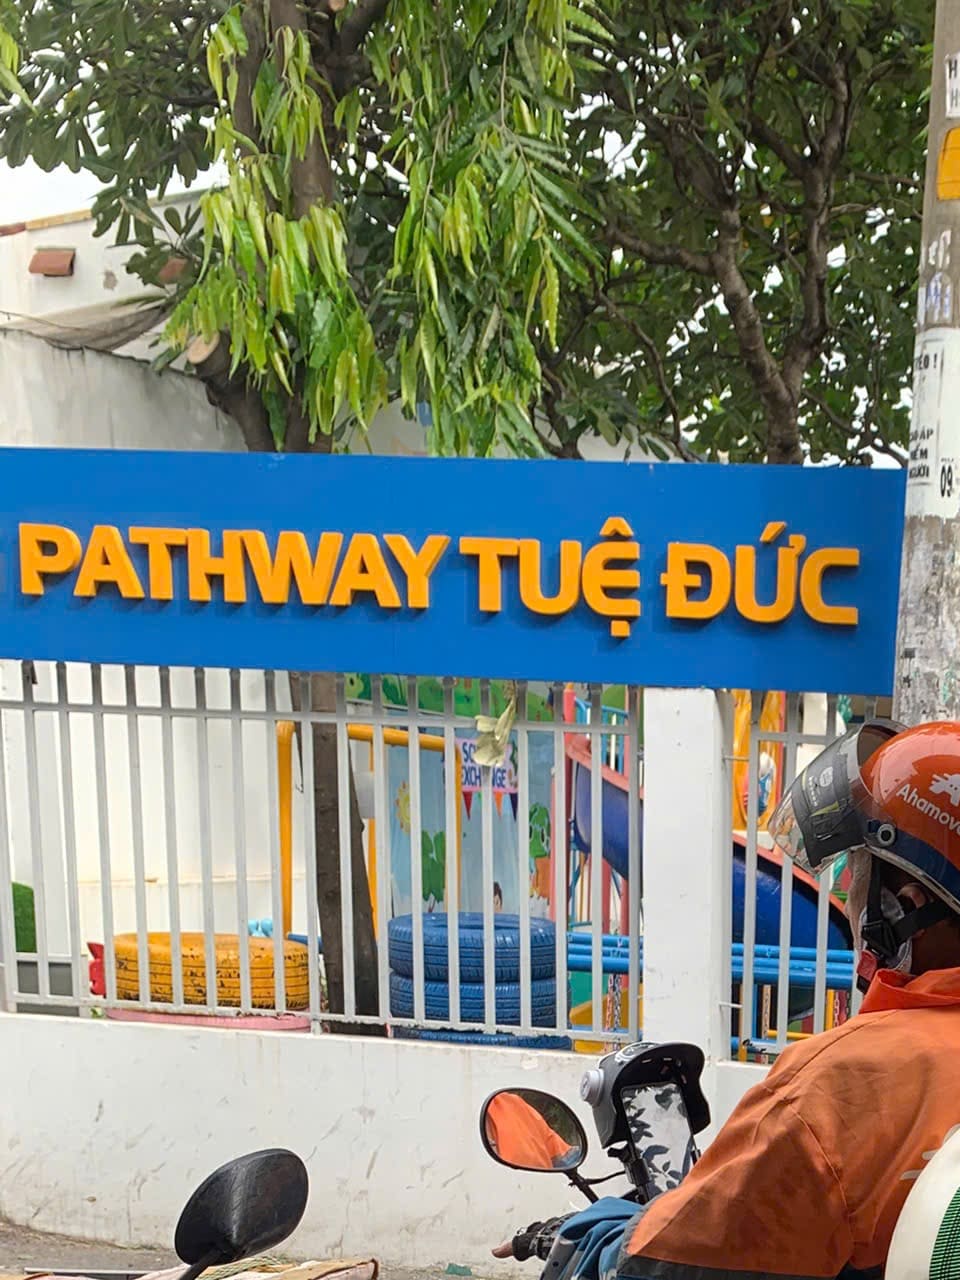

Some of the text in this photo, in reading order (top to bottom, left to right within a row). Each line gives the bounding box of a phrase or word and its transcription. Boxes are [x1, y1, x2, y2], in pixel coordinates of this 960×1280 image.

[18, 516, 860, 638] PATHWAY TUỆ ĐỨC
